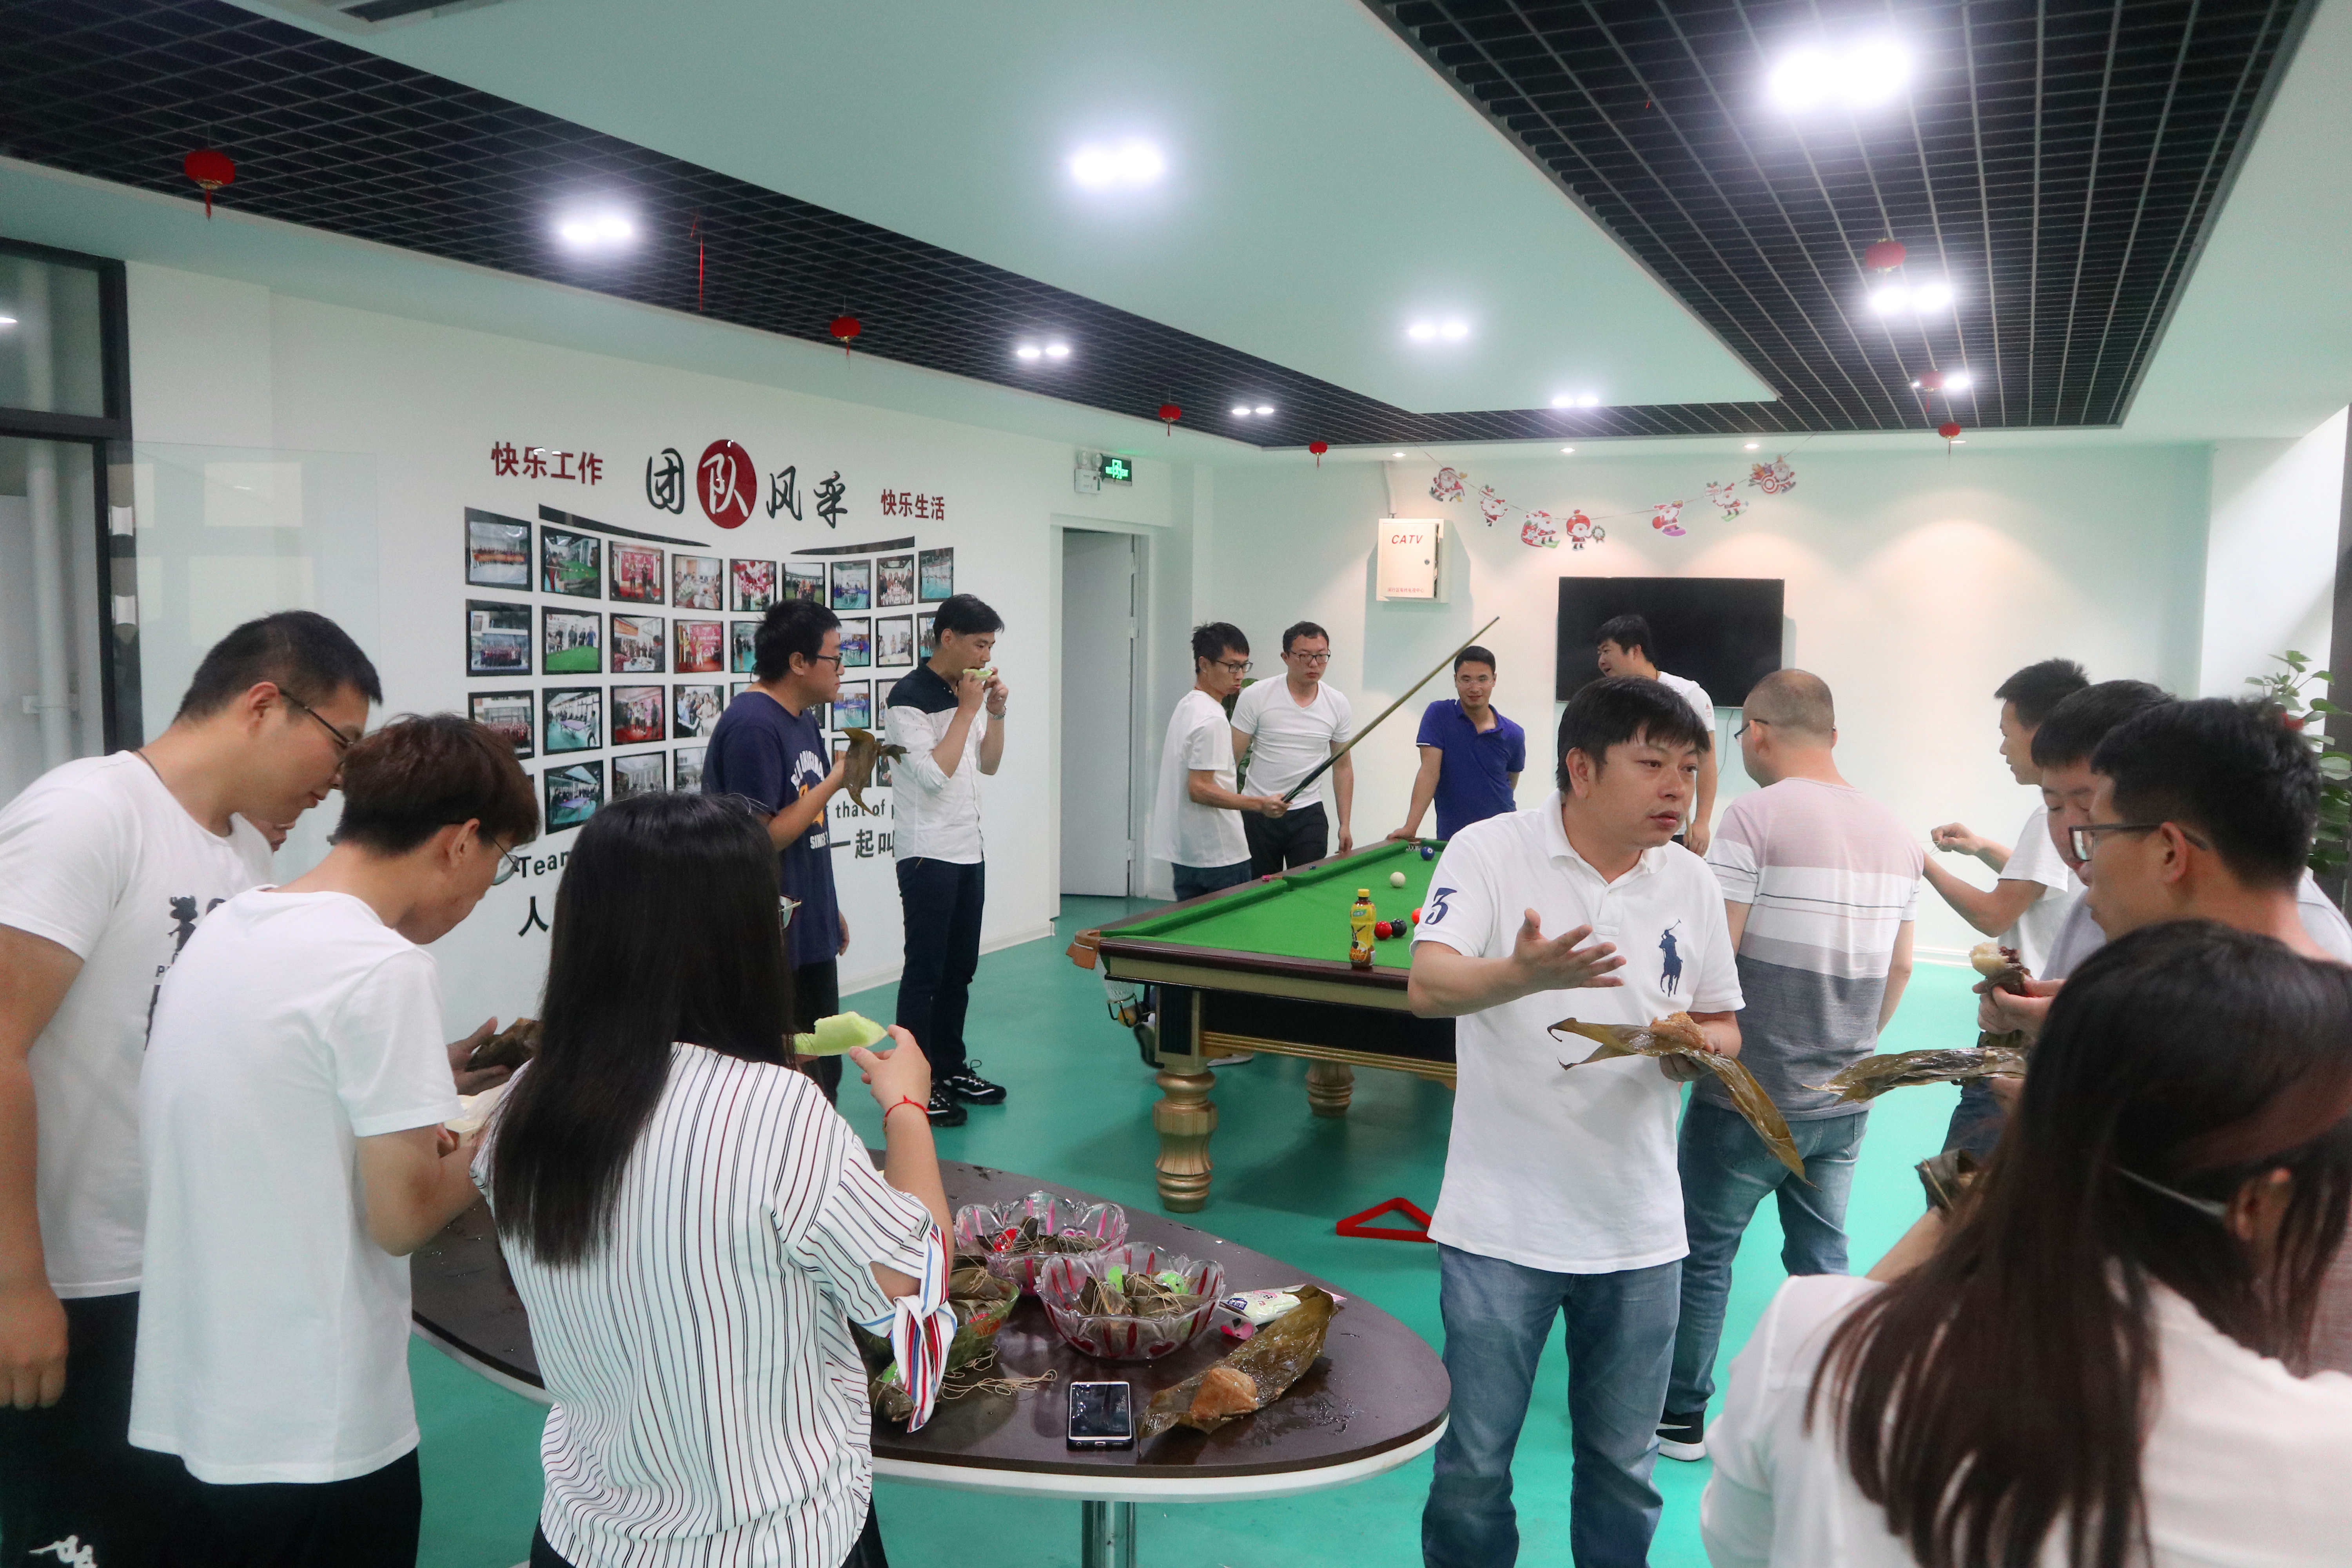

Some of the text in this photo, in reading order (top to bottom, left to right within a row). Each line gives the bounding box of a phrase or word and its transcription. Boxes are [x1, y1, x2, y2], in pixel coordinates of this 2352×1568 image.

[491, 441, 603, 485] 快乐工作
[646, 448, 848, 528] 团队风采
[881, 489, 945, 521] 快乐生活
[1392, 535, 1423, 544] CATV
[873, 799, 885, 816] of
[1425, 887, 1457, 925] 3
